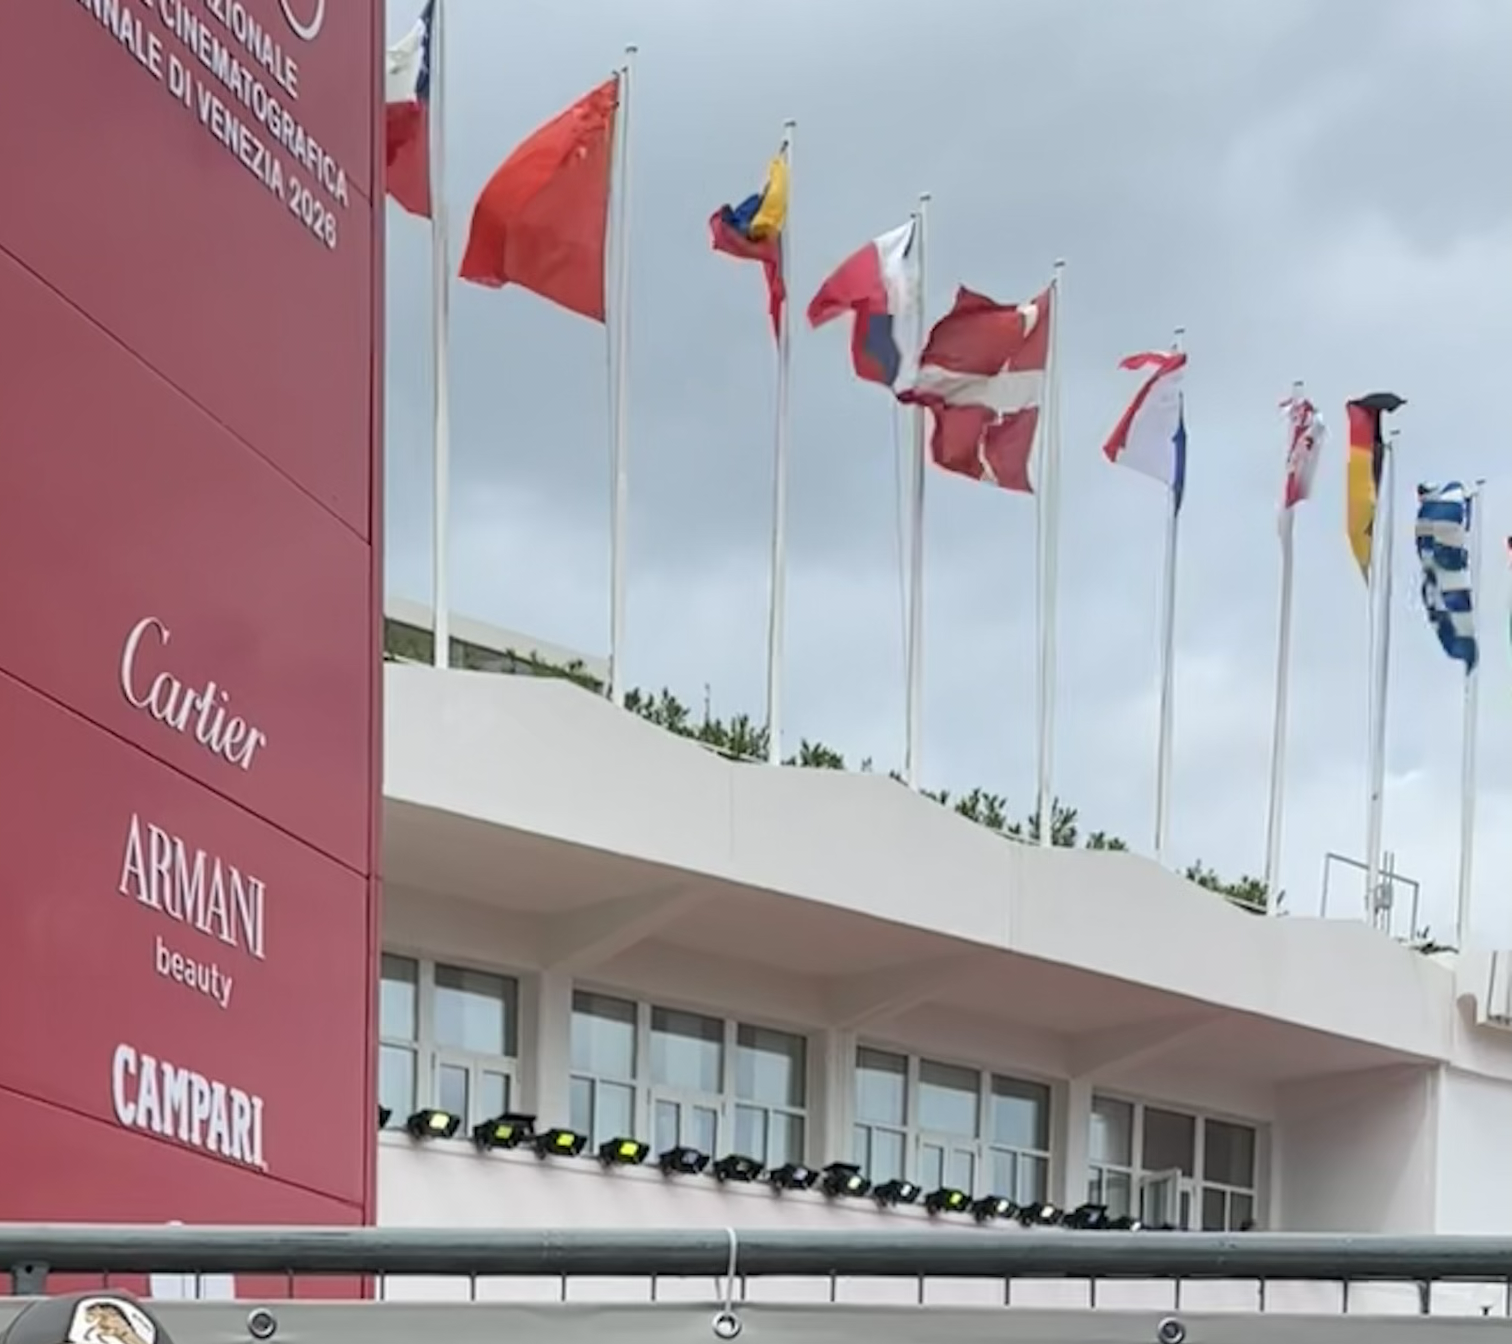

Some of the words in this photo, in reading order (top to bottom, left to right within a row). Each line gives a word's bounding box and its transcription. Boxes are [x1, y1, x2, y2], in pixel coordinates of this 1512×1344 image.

[159, 0, 349, 206] CINEMATOGRAFICA
[169, 54, 191, 107] DI
[197, 81, 285, 200] VENEZIA
[289, 177, 337, 249] 2026
[120, 617, 267, 769] Cartier
[119, 814, 265, 960] ARMANI
[155, 936, 234, 1006] beauty
[113, 1044, 264, 1166] CAMPARI
